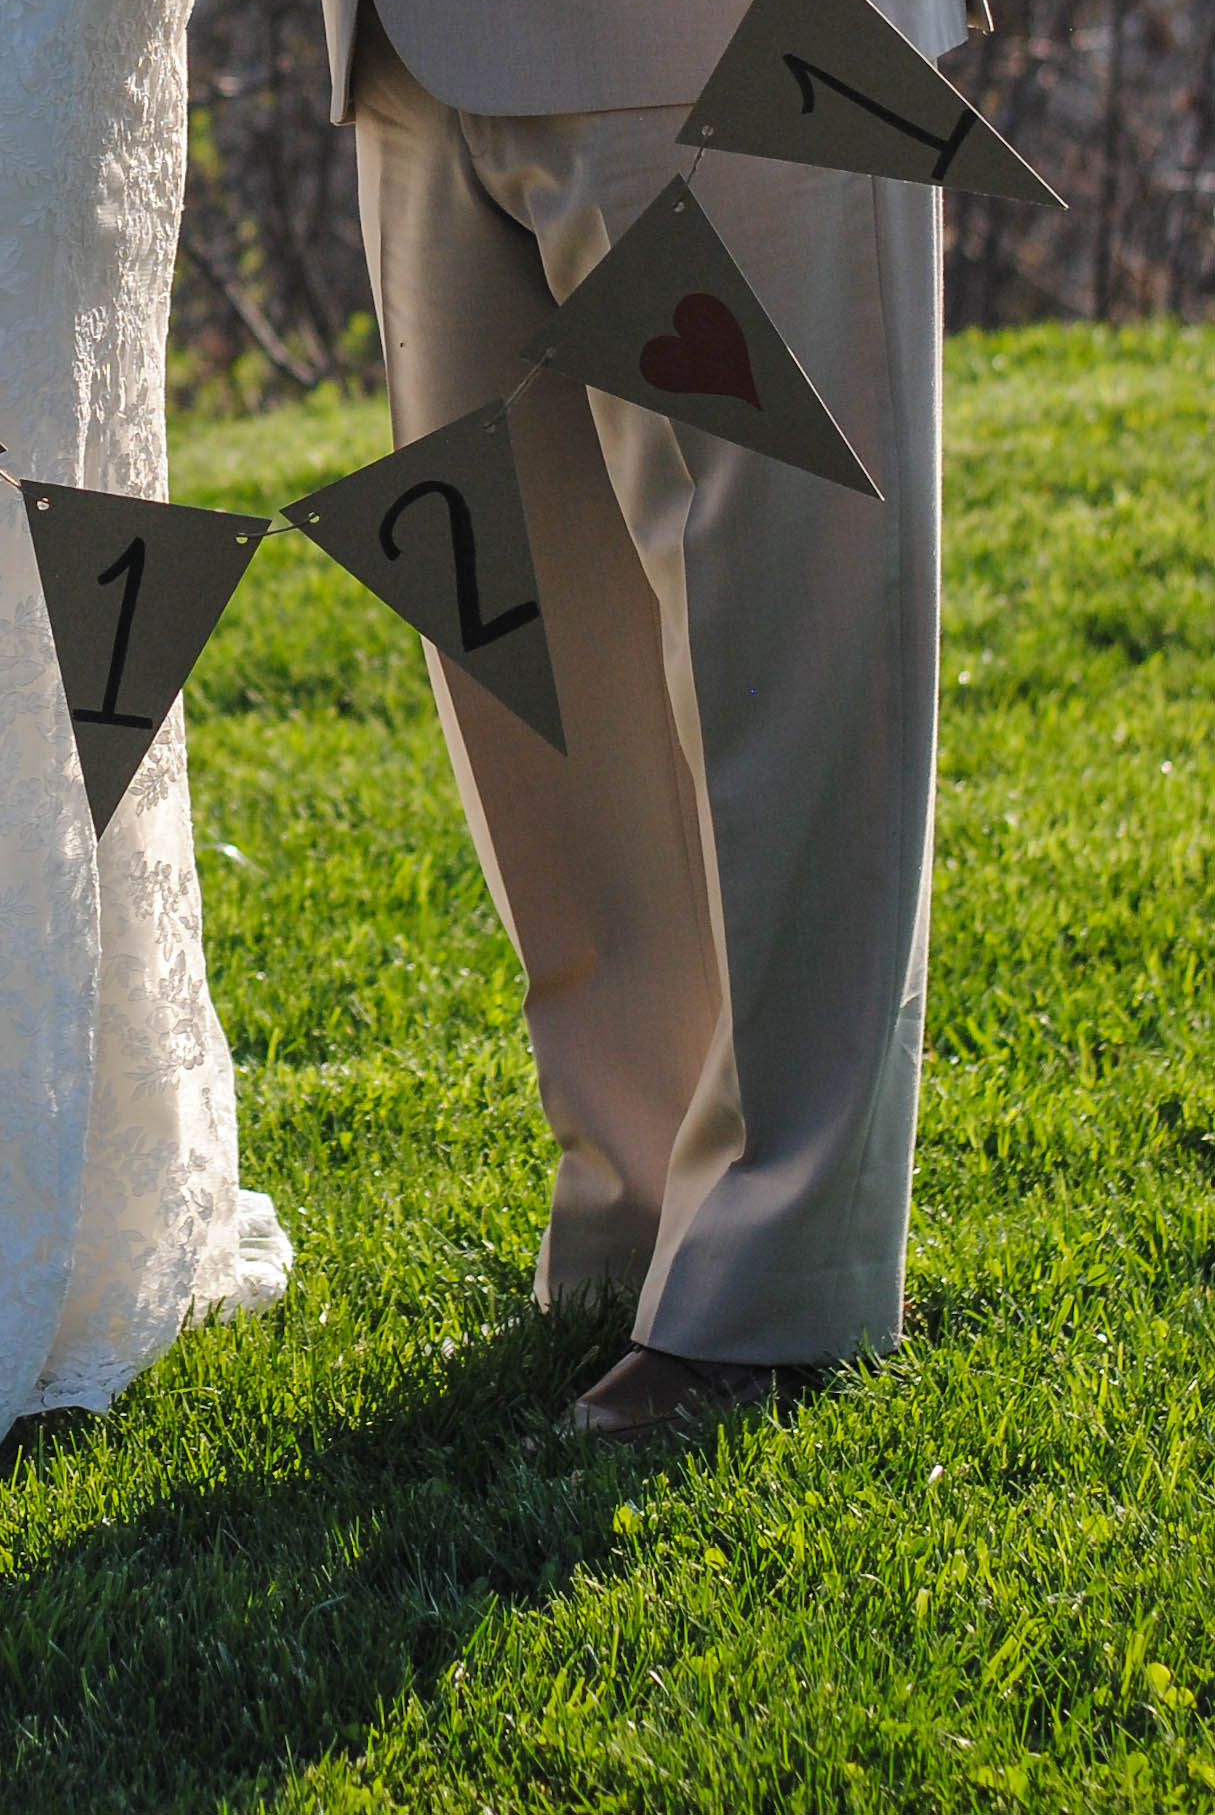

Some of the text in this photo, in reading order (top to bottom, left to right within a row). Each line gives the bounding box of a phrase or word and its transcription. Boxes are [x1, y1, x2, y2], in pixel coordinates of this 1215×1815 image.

[73, 537, 153, 730] 1
[379, 480, 541, 652] 2
[784, 53, 978, 182] 1
